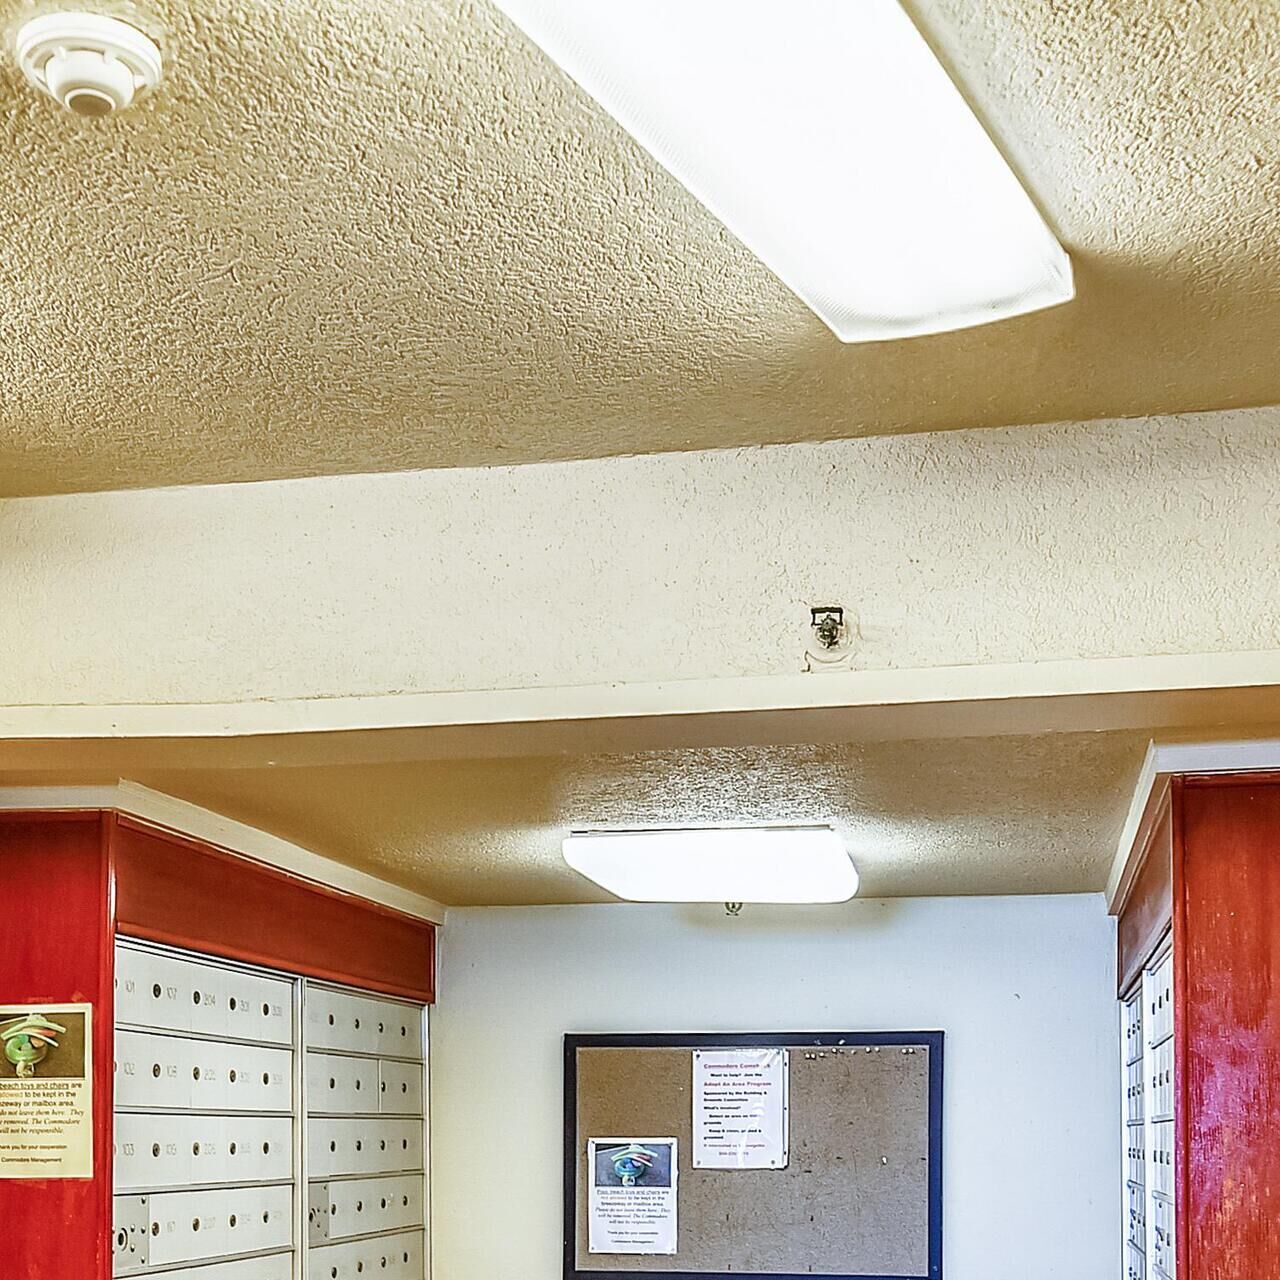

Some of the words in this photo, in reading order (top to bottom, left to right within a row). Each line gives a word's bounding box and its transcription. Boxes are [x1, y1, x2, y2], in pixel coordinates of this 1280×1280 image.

[0, 1082, 19, 1090] beach
[20, 1082, 34, 1090] toys
[36, 1082, 49, 1090] and
[50, 1082, 69, 1090] chairs
